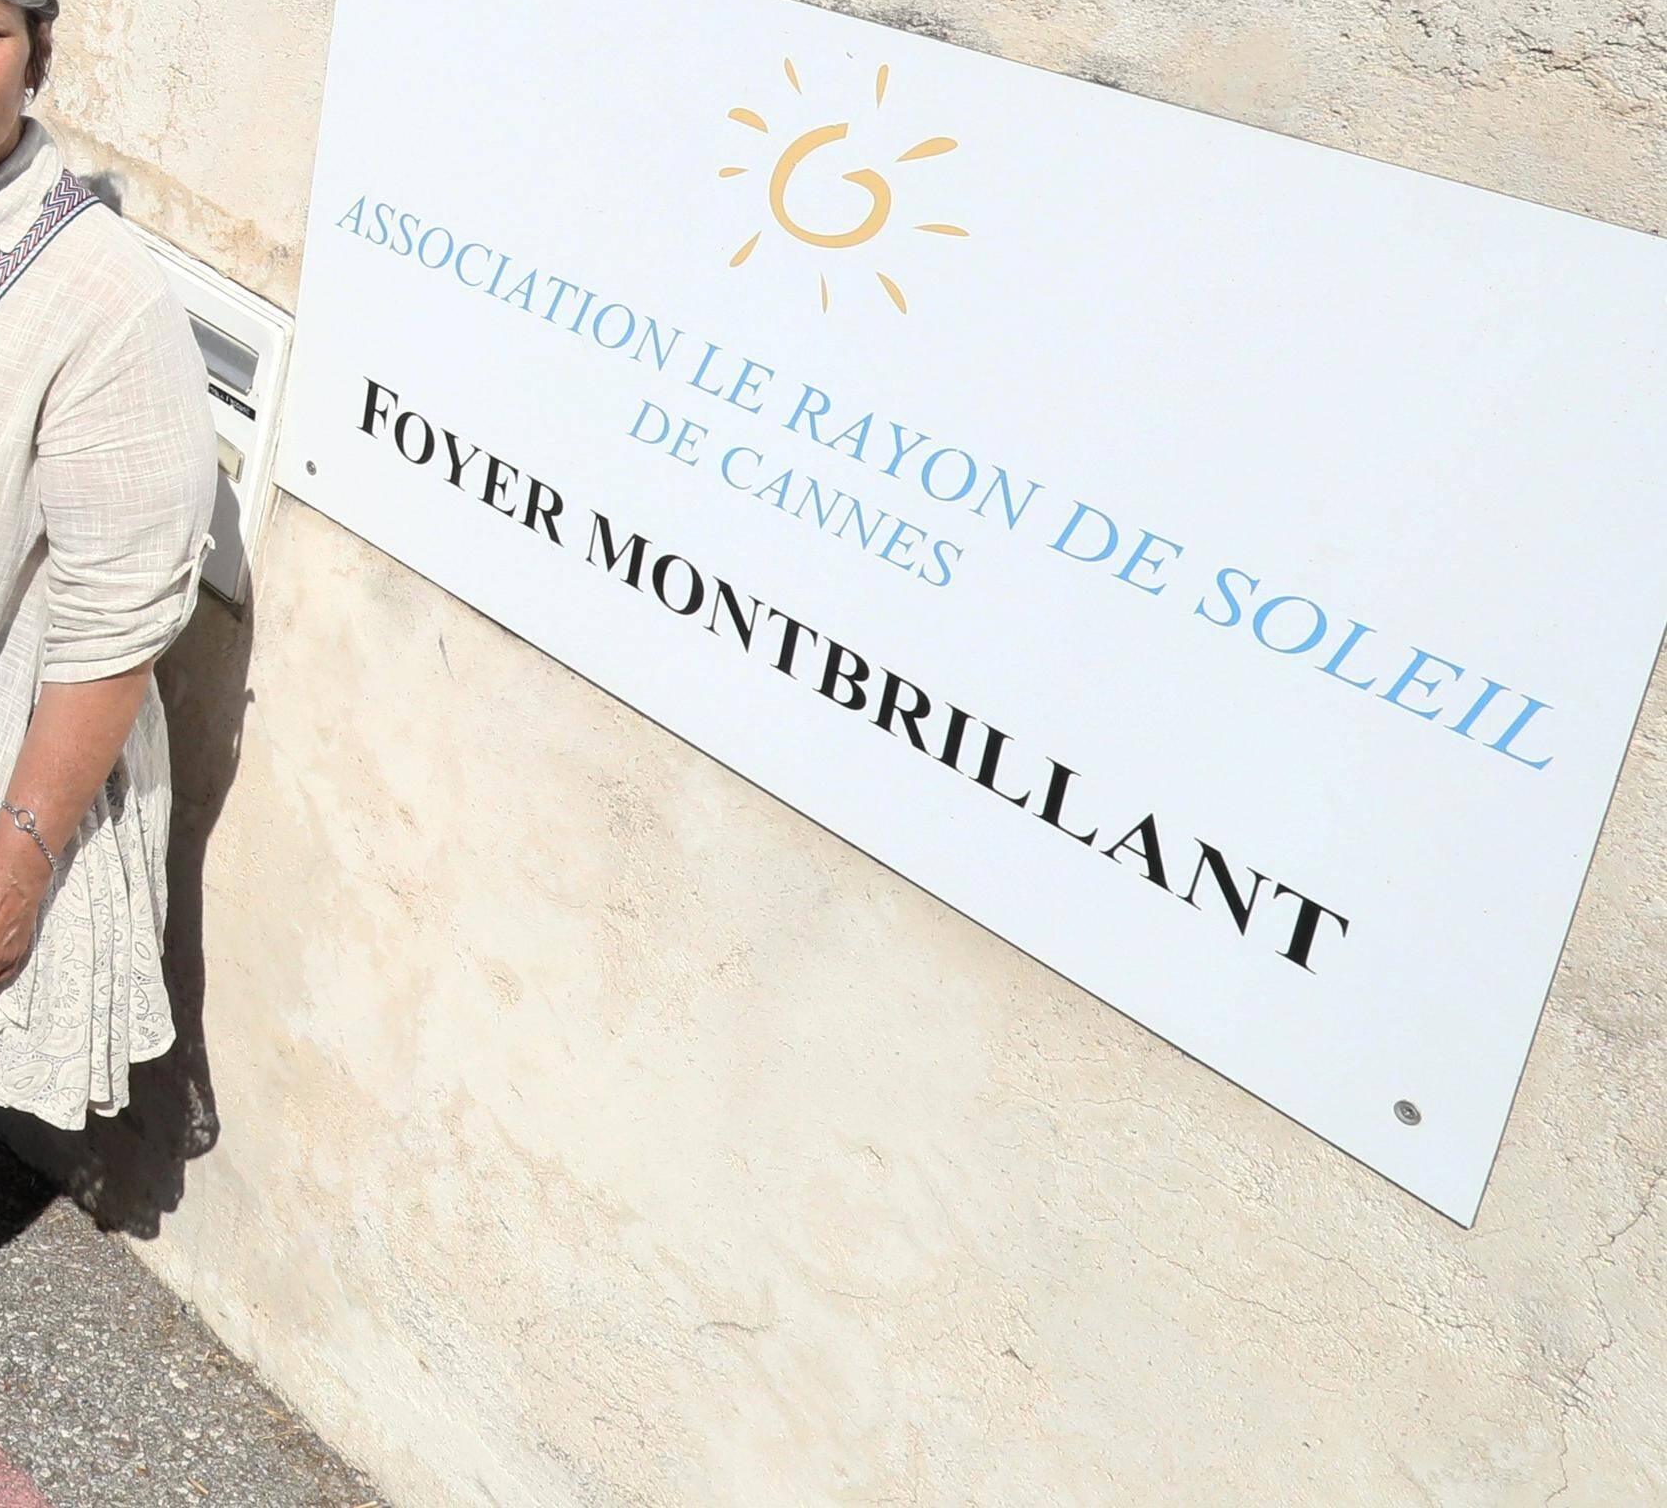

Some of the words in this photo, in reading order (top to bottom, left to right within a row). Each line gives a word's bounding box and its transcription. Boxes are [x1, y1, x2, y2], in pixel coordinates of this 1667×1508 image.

[336, 193, 690, 374] ASSOCIATION
[687, 339, 776, 414] LE
[783, 382, 1045, 534] RAYON
[1049, 499, 1185, 598] DE
[1194, 564, 1555, 773] SOLEIL
[357, 377, 565, 545] FOYER
[586, 511, 1350, 975] MONTBRILLANT
[627, 399, 711, 467] DE
[720, 445, 964, 590] CANNES
